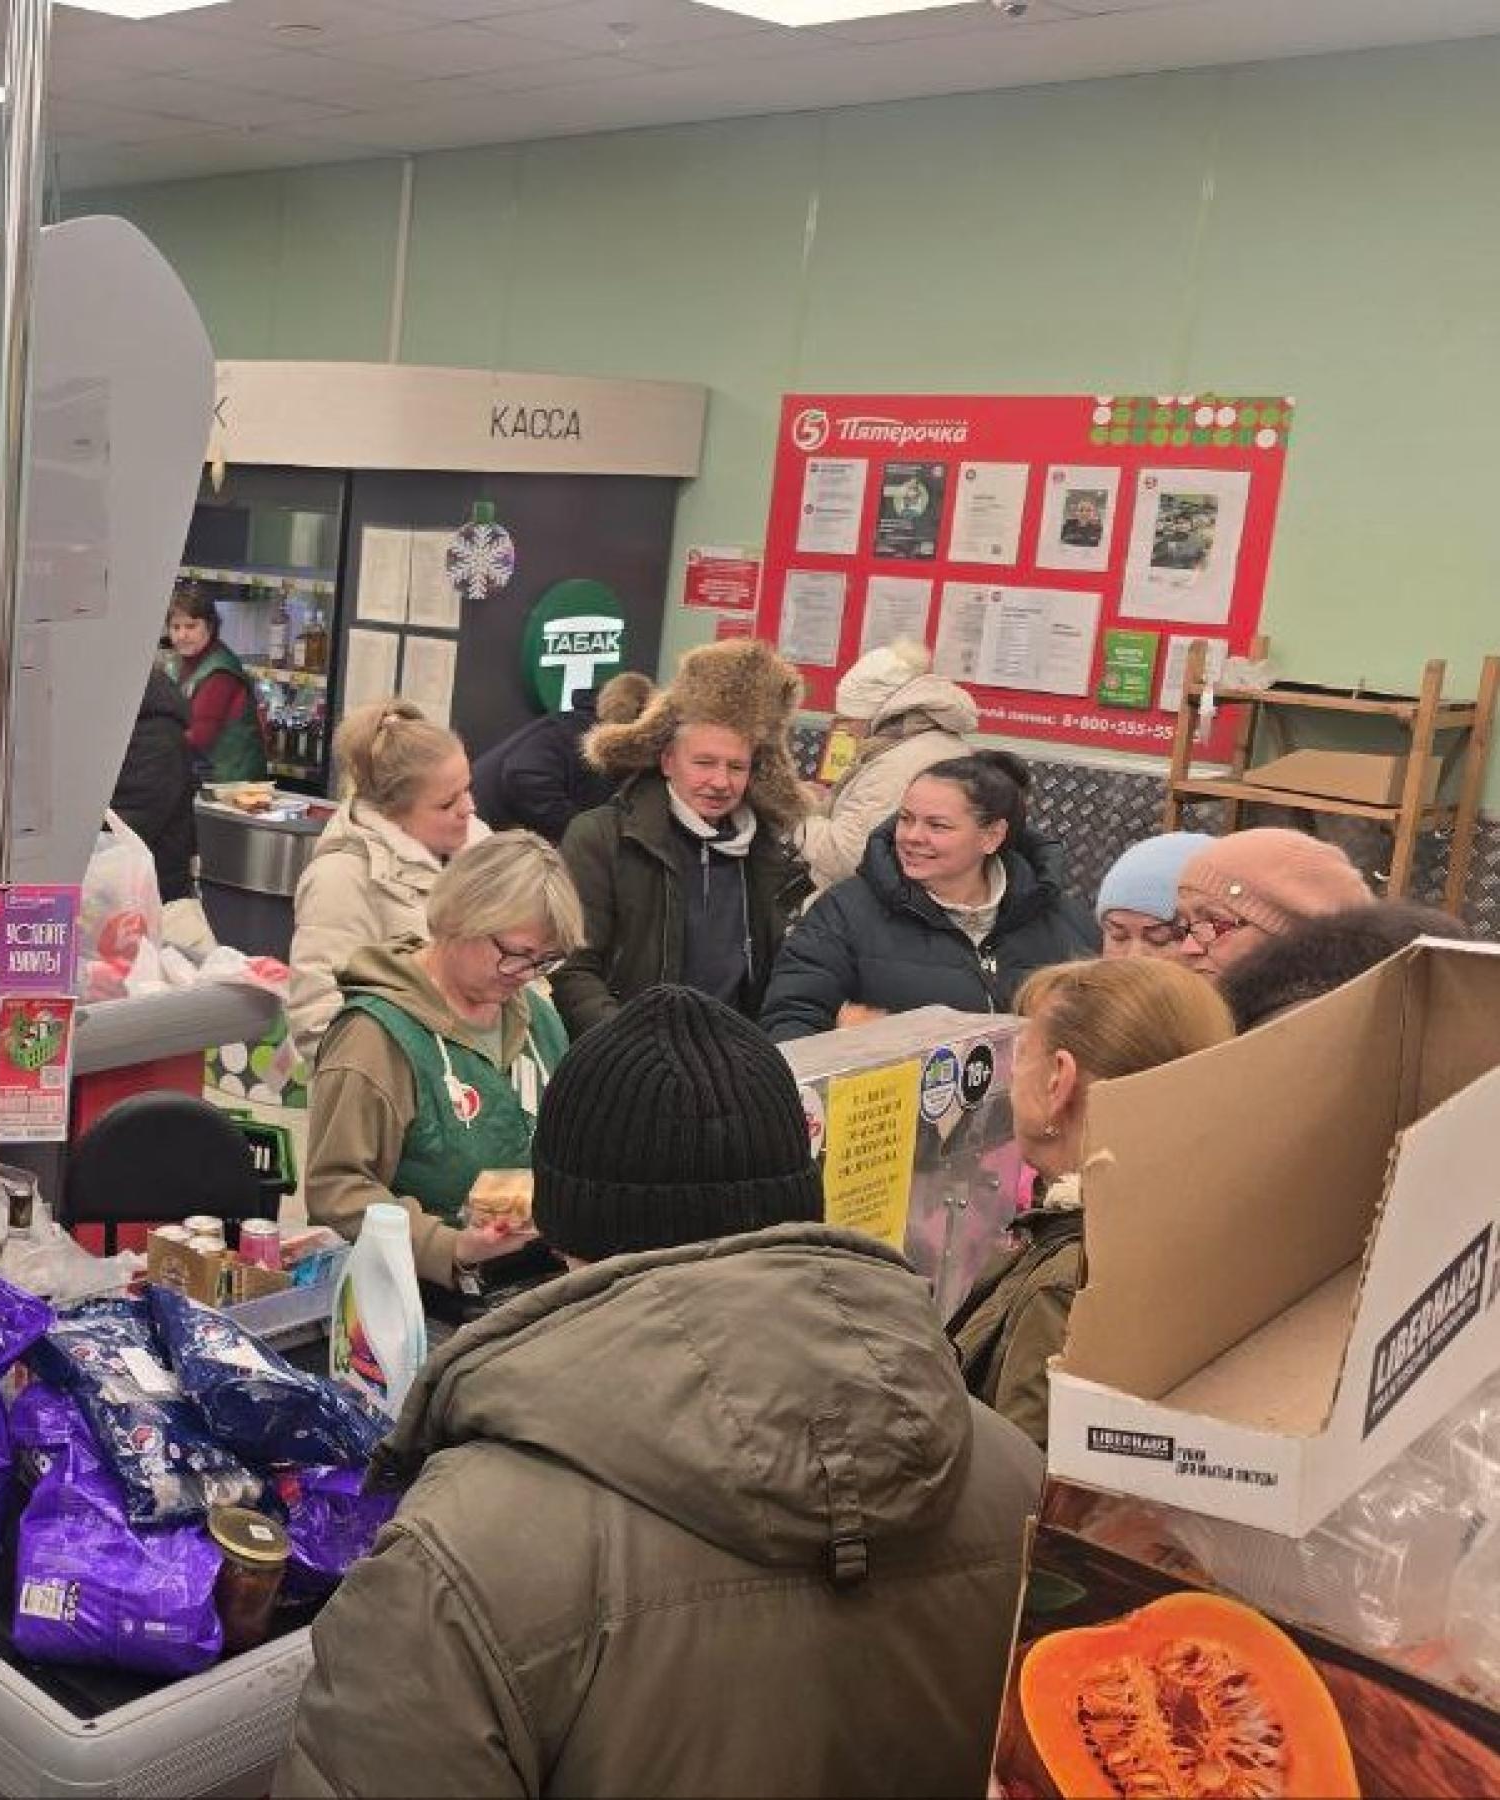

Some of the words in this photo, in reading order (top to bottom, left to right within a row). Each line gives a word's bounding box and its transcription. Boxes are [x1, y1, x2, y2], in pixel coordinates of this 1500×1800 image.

[490, 404, 581, 441] КАССА
[543, 631, 622, 654] ТАБАК
[6, 918, 68, 945] УСПЕЙТЕ
[967, 1061, 991, 1087] 18+
[1375, 1242, 1483, 1394] LIBERHAUS
[1092, 1428, 1170, 1450] LIBERHAUS
